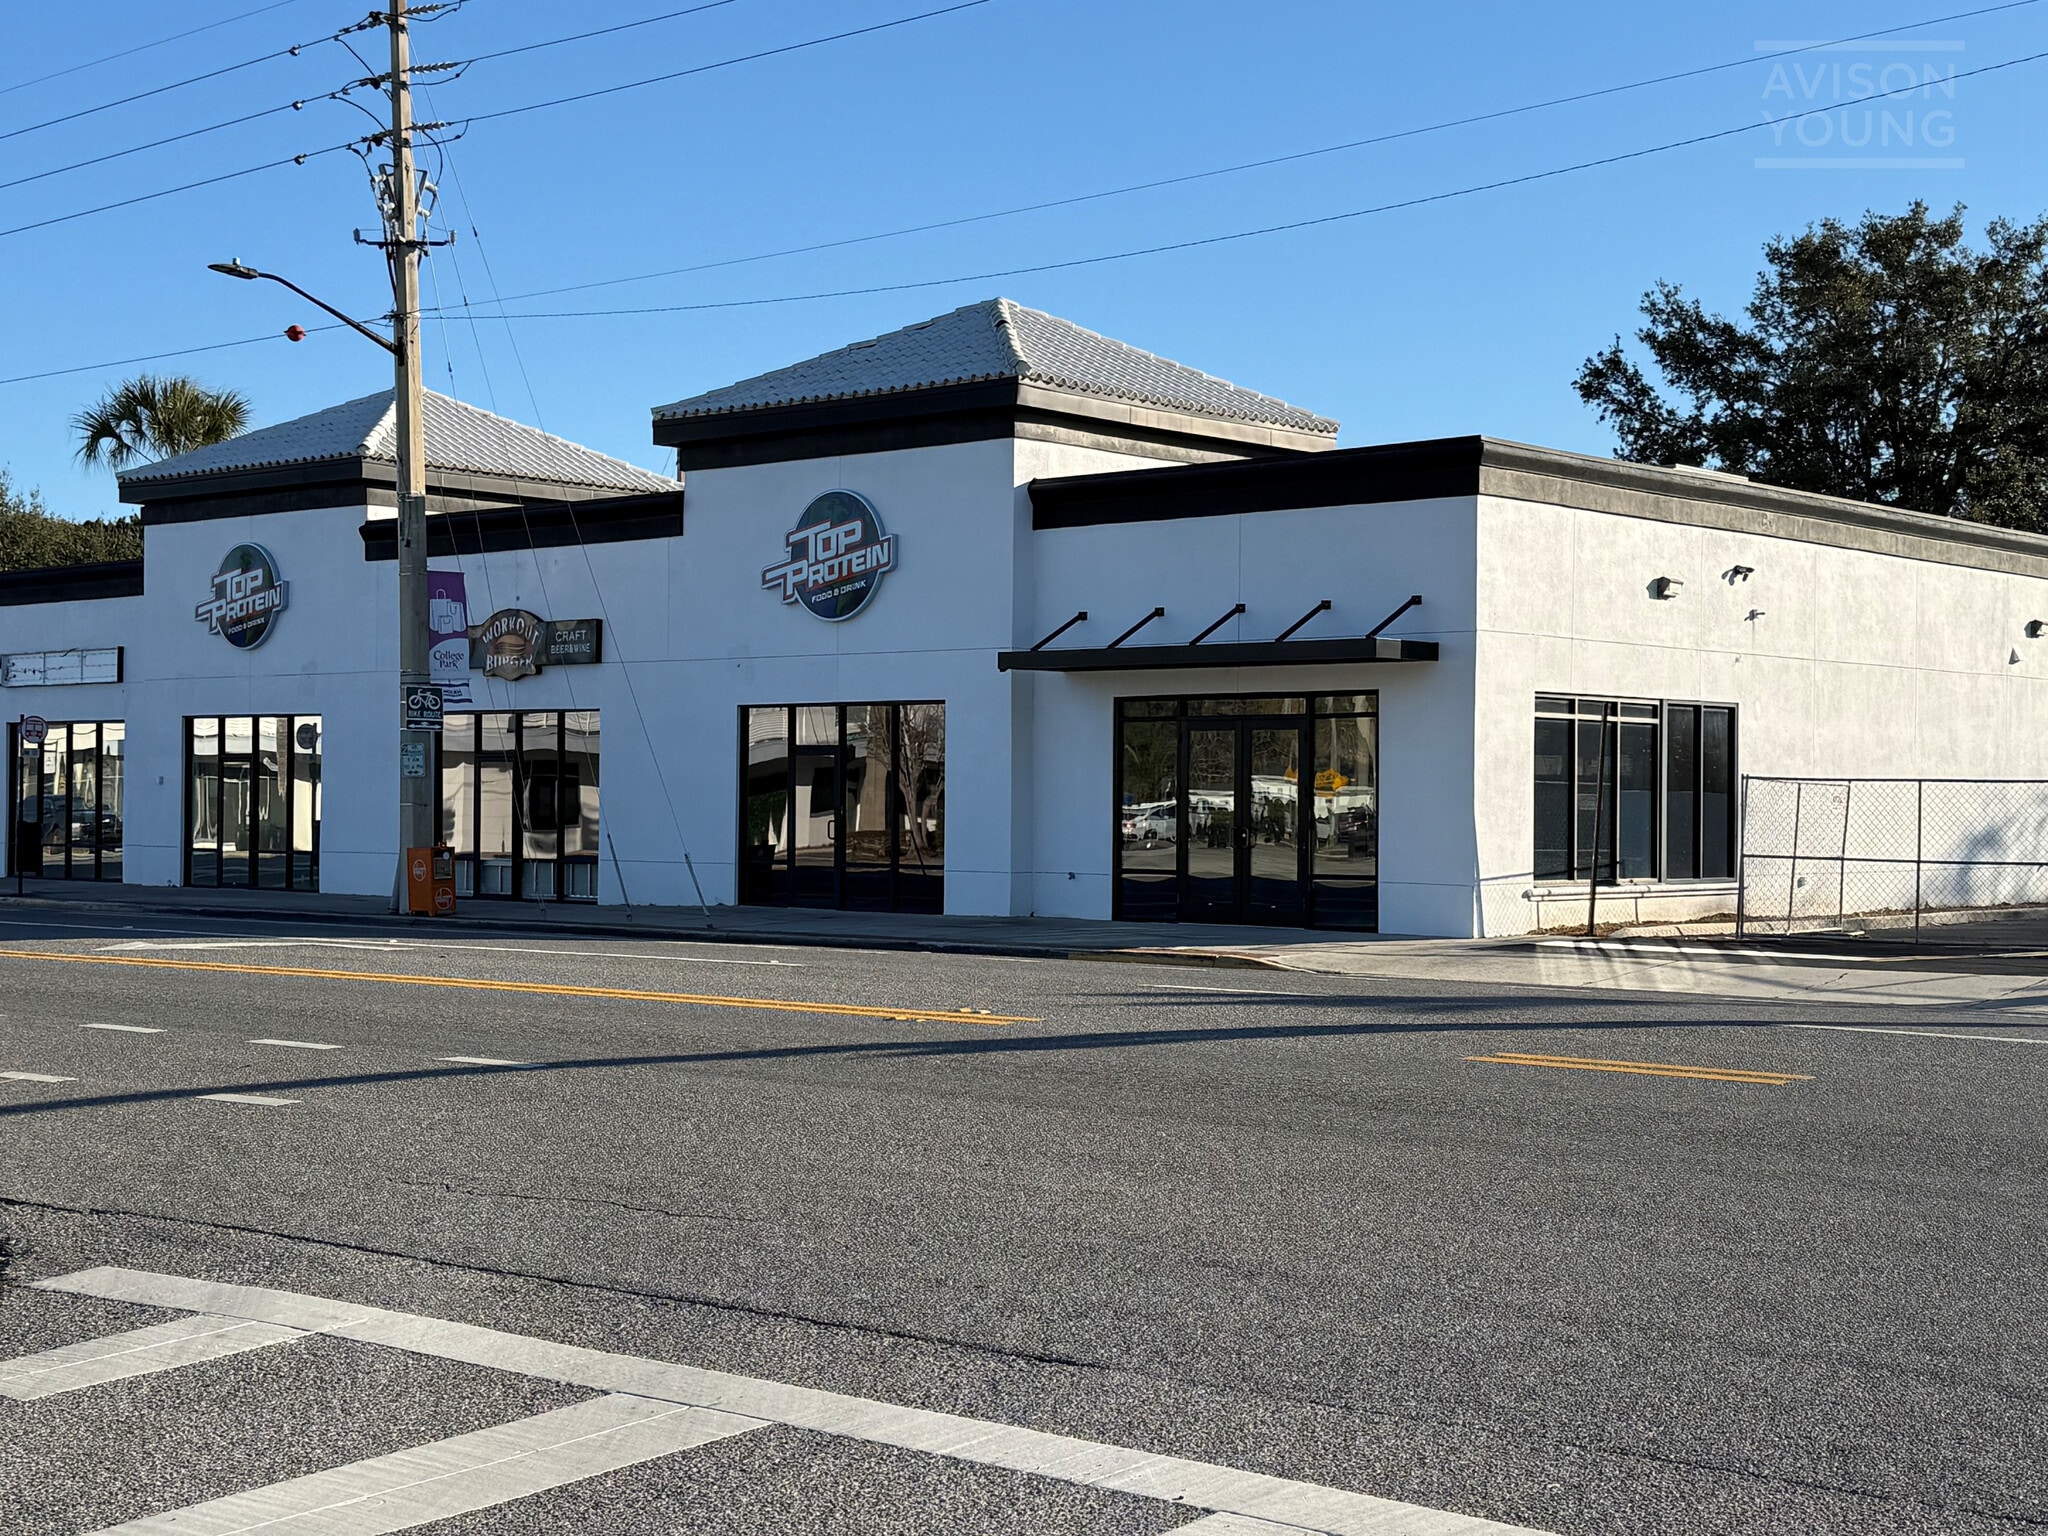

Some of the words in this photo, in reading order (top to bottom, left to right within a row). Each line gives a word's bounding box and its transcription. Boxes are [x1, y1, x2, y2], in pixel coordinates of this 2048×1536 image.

[789, 520, 862, 564] TOP
[765, 542, 889, 596] PROTEIN
[214, 568, 262, 602] TOP
[811, 590, 832, 603] FOOD
[840, 579, 867, 594] DRINK
[198, 587, 280, 628] PROTEIN
[482, 616, 539, 645] WORKOUT
[555, 630, 586, 642] CRAFT
[433, 650, 464, 661] College
[440, 660, 458, 669] Park
